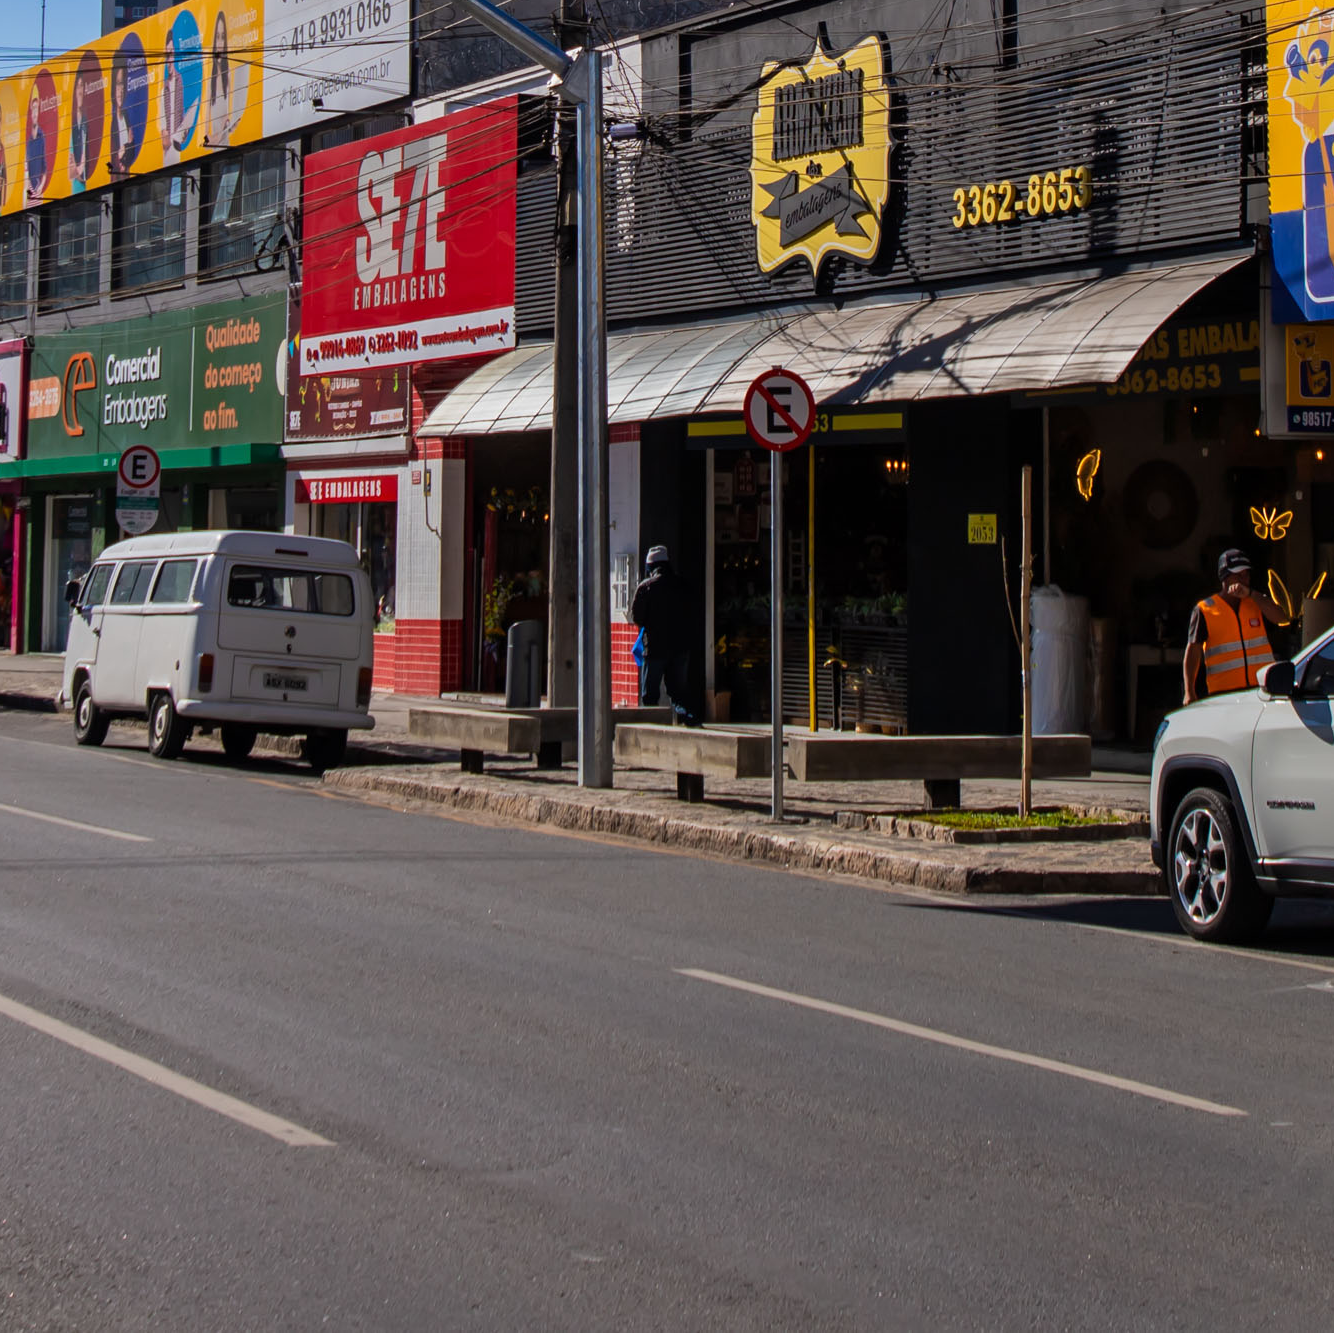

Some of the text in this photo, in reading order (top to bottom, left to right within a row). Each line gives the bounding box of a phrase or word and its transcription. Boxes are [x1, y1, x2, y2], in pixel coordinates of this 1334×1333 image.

[291, 24, 304, 56] 41
[308, 20, 316, 50] 9
[320, 5, 353, 45] 9931
[785, 182, 843, 230] embalagens
[952, 165, 1094, 229] 3362-8653
[354, 271, 446, 311] EMBALAGENS
[205, 316, 261, 353] Qualidade
[1134, 330, 1171, 362] AS
[105, 345, 163, 387] Comercial
[204, 361, 263, 394] do começo
[103, 392, 168, 430] Embalagens
[203, 401, 239, 432] ao fim.
[132, 454, 147, 479] E
[325, 479, 382, 499] EMBALAGENS
[970, 526, 994, 542] 2053
